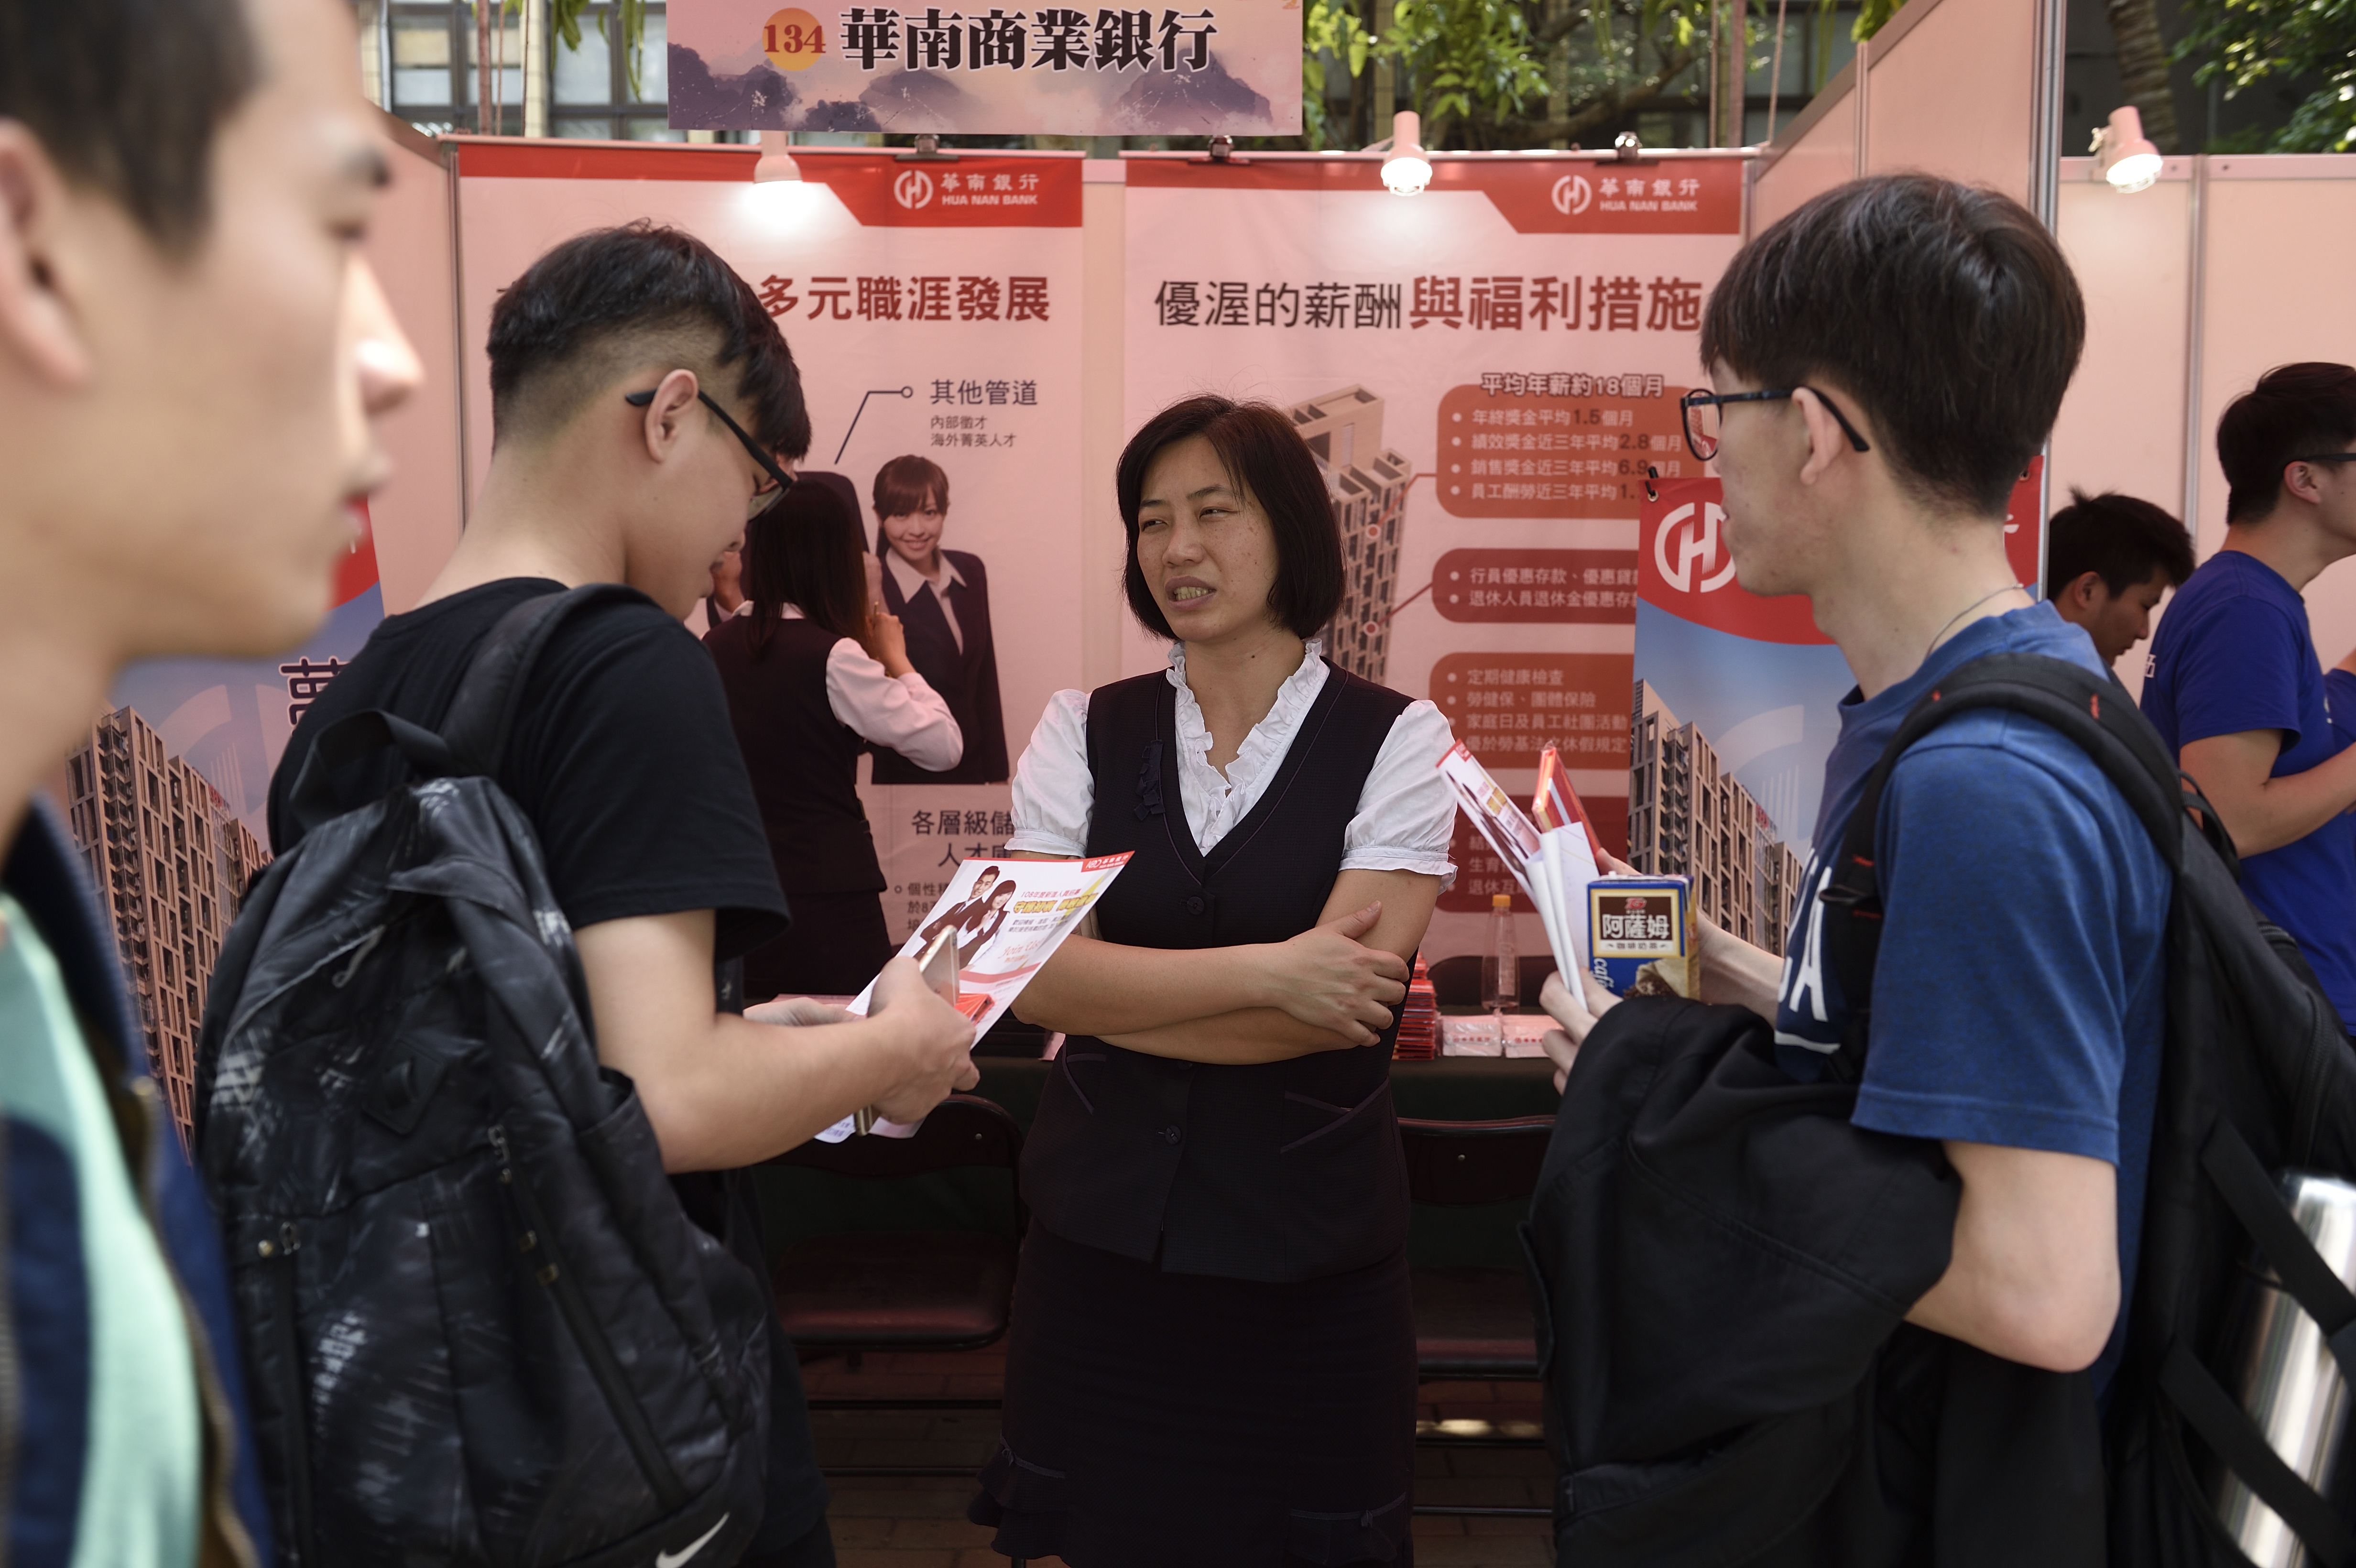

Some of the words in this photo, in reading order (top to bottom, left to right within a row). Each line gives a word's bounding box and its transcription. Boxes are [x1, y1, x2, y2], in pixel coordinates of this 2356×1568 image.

[763, 24, 826, 54] 134
[840, 7, 1215, 71] 華南商業銀行
[940, 173, 1039, 192] 華南銀行
[1599, 177, 1701, 197] 華南銀行
[942, 195, 969, 206] HUA
[971, 195, 1000, 206] NAN
[1003, 194, 1038, 206] BANK
[1600, 200, 1626, 211] HUA
[1629, 200, 1659, 211] NAN
[1661, 200, 1698, 211] BANK
[758, 274, 1049, 322] 多元職涯發展
[1154, 275, 1702, 332] 優渥的薪酬與福利措施
[930, 379, 1038, 405] 其他管道
[1482, 373, 1664, 397] 平均年薪約18個月
[930, 433, 1017, 447] 海外菁英人才
[1602, 914, 1669, 939] 阿薩姆
